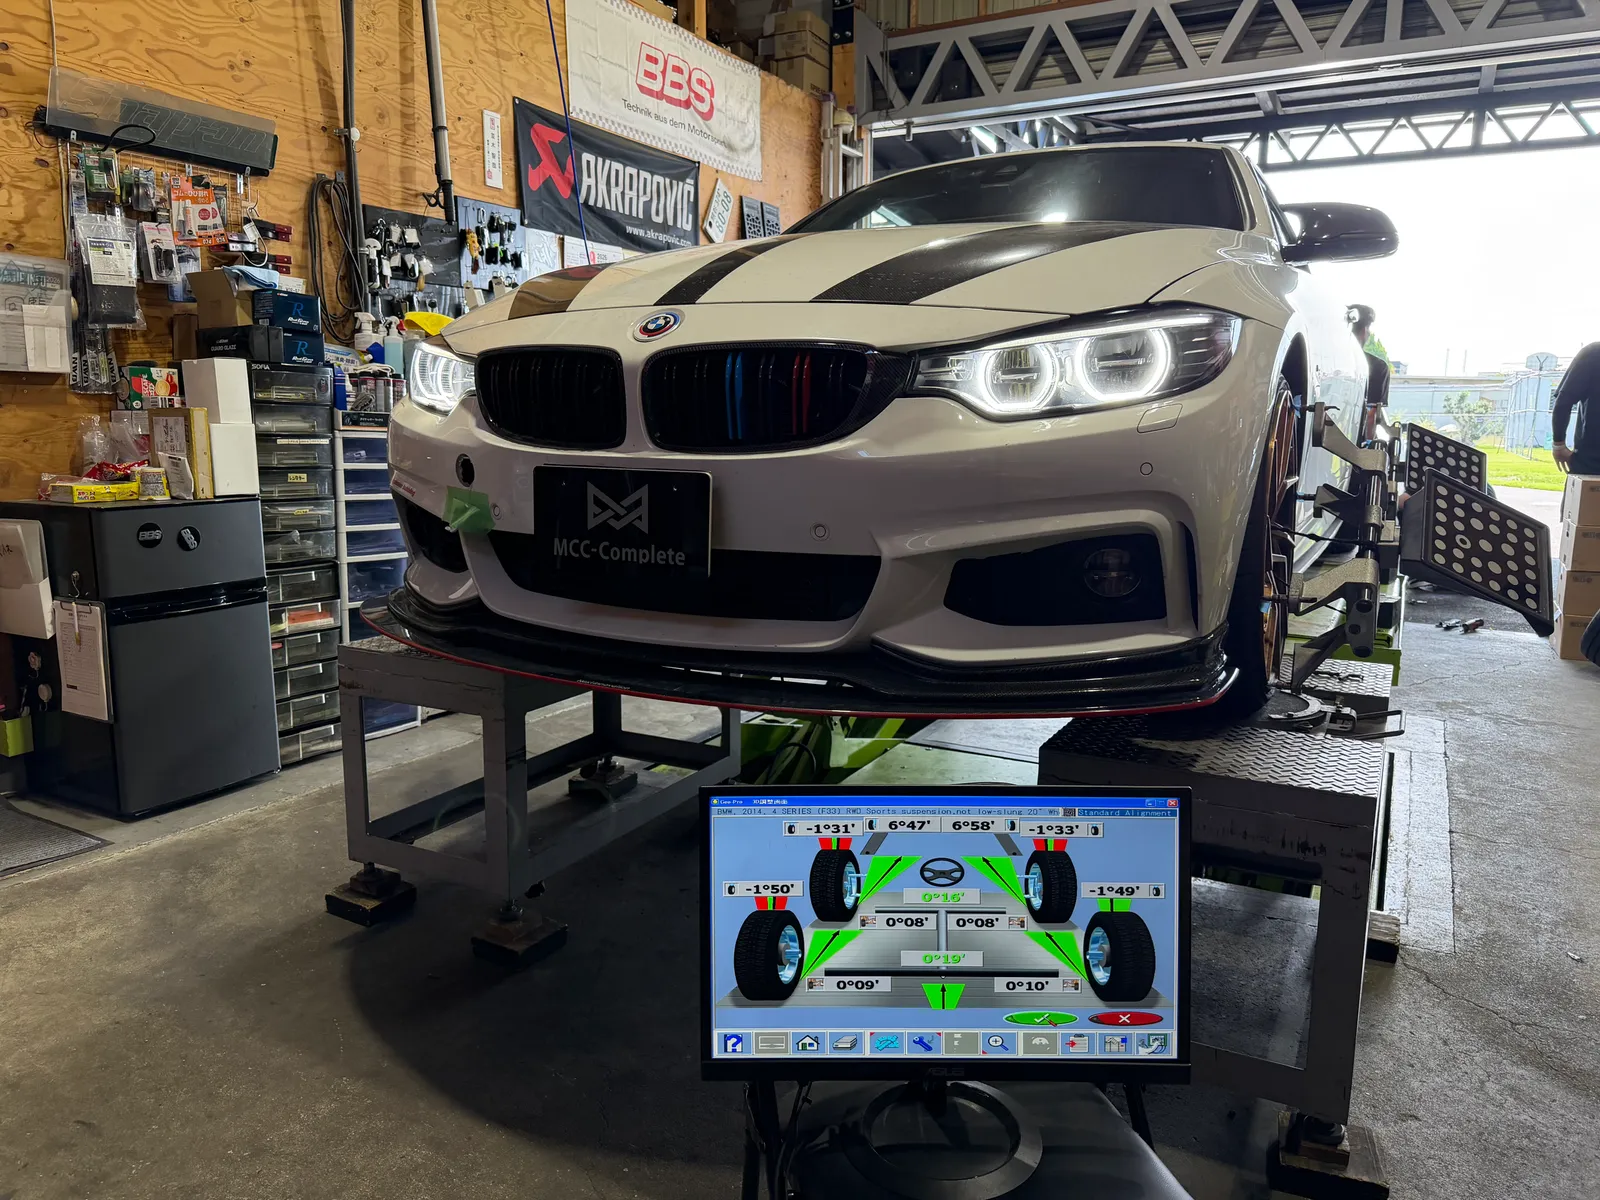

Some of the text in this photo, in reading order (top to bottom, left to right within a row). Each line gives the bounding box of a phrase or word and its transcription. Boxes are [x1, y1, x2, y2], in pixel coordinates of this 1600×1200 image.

[636, 41, 715, 121] BBS
[622, 98, 653, 119] Technik
[654, 113, 668, 124] aus
[669, 118, 686, 130] dem
[553, 537, 686, 566] MCC-Complete
[817, 807, 841, 816] (F33)
[866, 808, 897, 816] Sports
[978, 808, 1023, 817] low-slung
[1078, 809, 1172, 818] Standard Alignment
[806, 823, 856, 834] -1°31'
[888, 820, 931, 831] 6°47'
[952, 820, 995, 831] 6°58'
[1028, 824, 1080, 835] -1°33'
[745, 883, 795, 894] -1°50'
[1089, 885, 1140, 896] -1°49'
[921, 892, 965, 903] 0°16'
[885, 916, 929, 928] 0°08'
[956, 917, 999, 928] 0°08'
[922, 953, 966, 964] 0°19'
[836, 979, 880, 990] 0°09'
[1005, 980, 1049, 991] 0°10'
